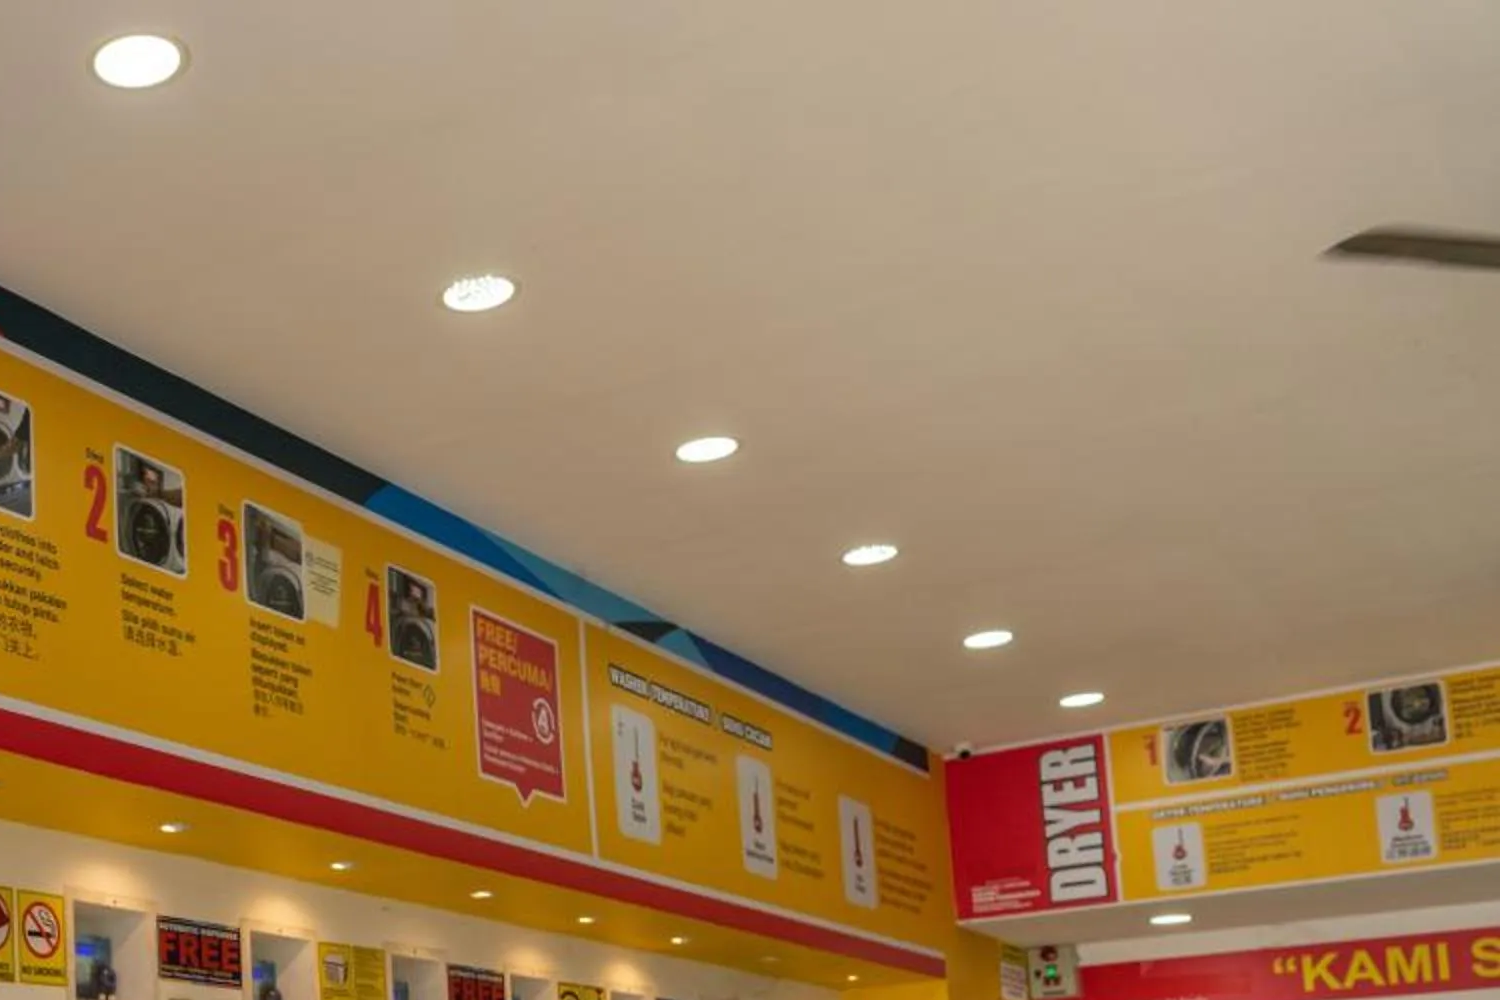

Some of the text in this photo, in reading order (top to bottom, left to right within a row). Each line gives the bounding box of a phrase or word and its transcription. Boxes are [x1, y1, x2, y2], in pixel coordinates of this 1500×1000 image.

[84, 463, 107, 543] 2
[217, 518, 238, 592] 3
[365, 581, 382, 648] 4
[1344, 706, 1362, 736] 2
[1038, 742, 1109, 903] DRYER
[159, 931, 241, 973] FREE
[1272, 941, 1452, 994] “KAMI
